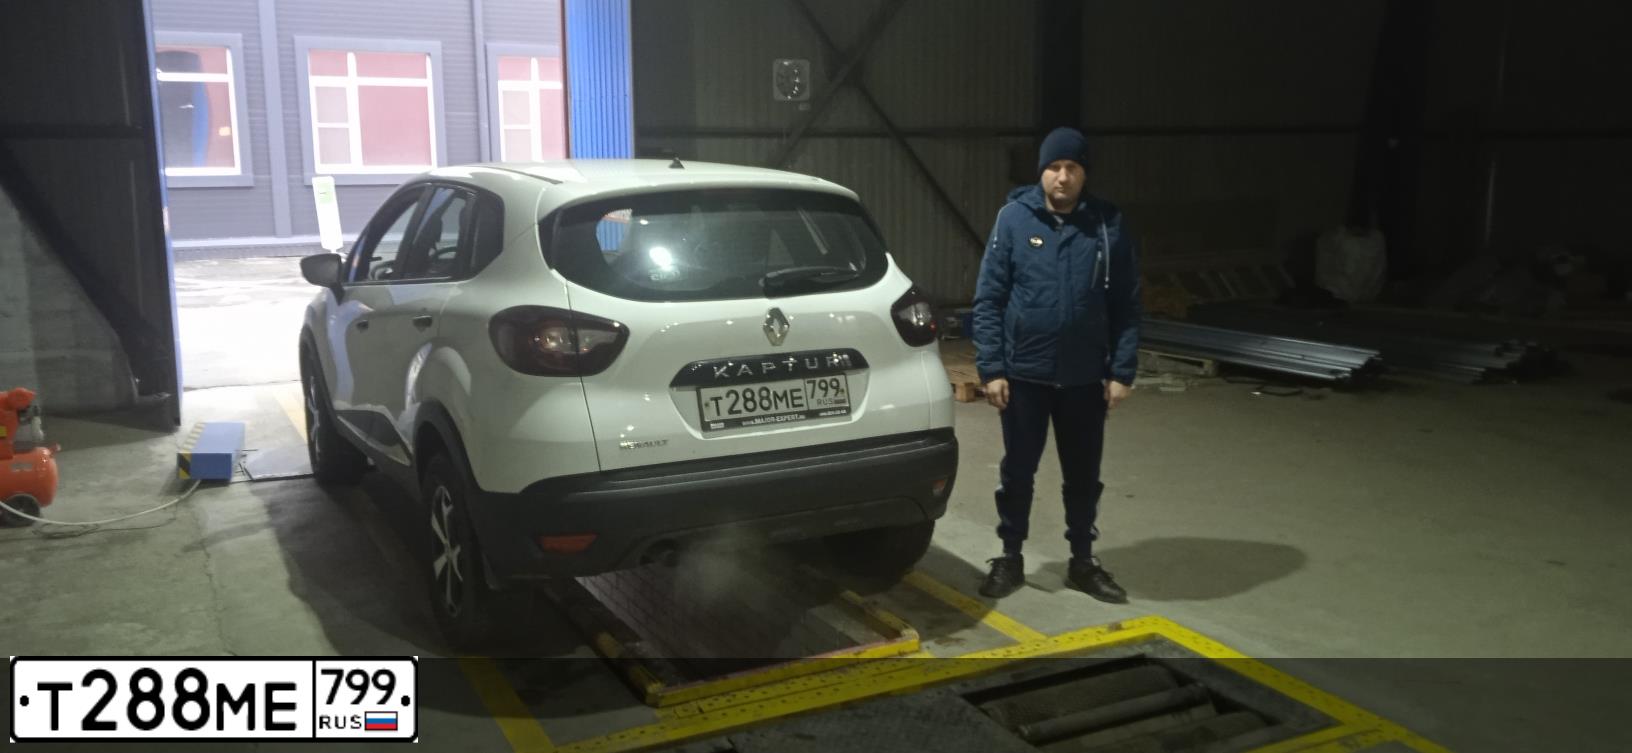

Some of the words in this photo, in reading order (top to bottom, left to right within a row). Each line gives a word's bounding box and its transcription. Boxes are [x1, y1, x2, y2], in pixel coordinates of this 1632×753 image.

[713, 355, 840, 378] KAPTUR
[807, 377, 841, 399] 799
[710, 386, 805, 416] T288ME
[816, 397, 833, 407] RUS
[742, 413, 806, 426] .MAJOR-EXPERT.
[619, 440, 669, 449] ENAULT
